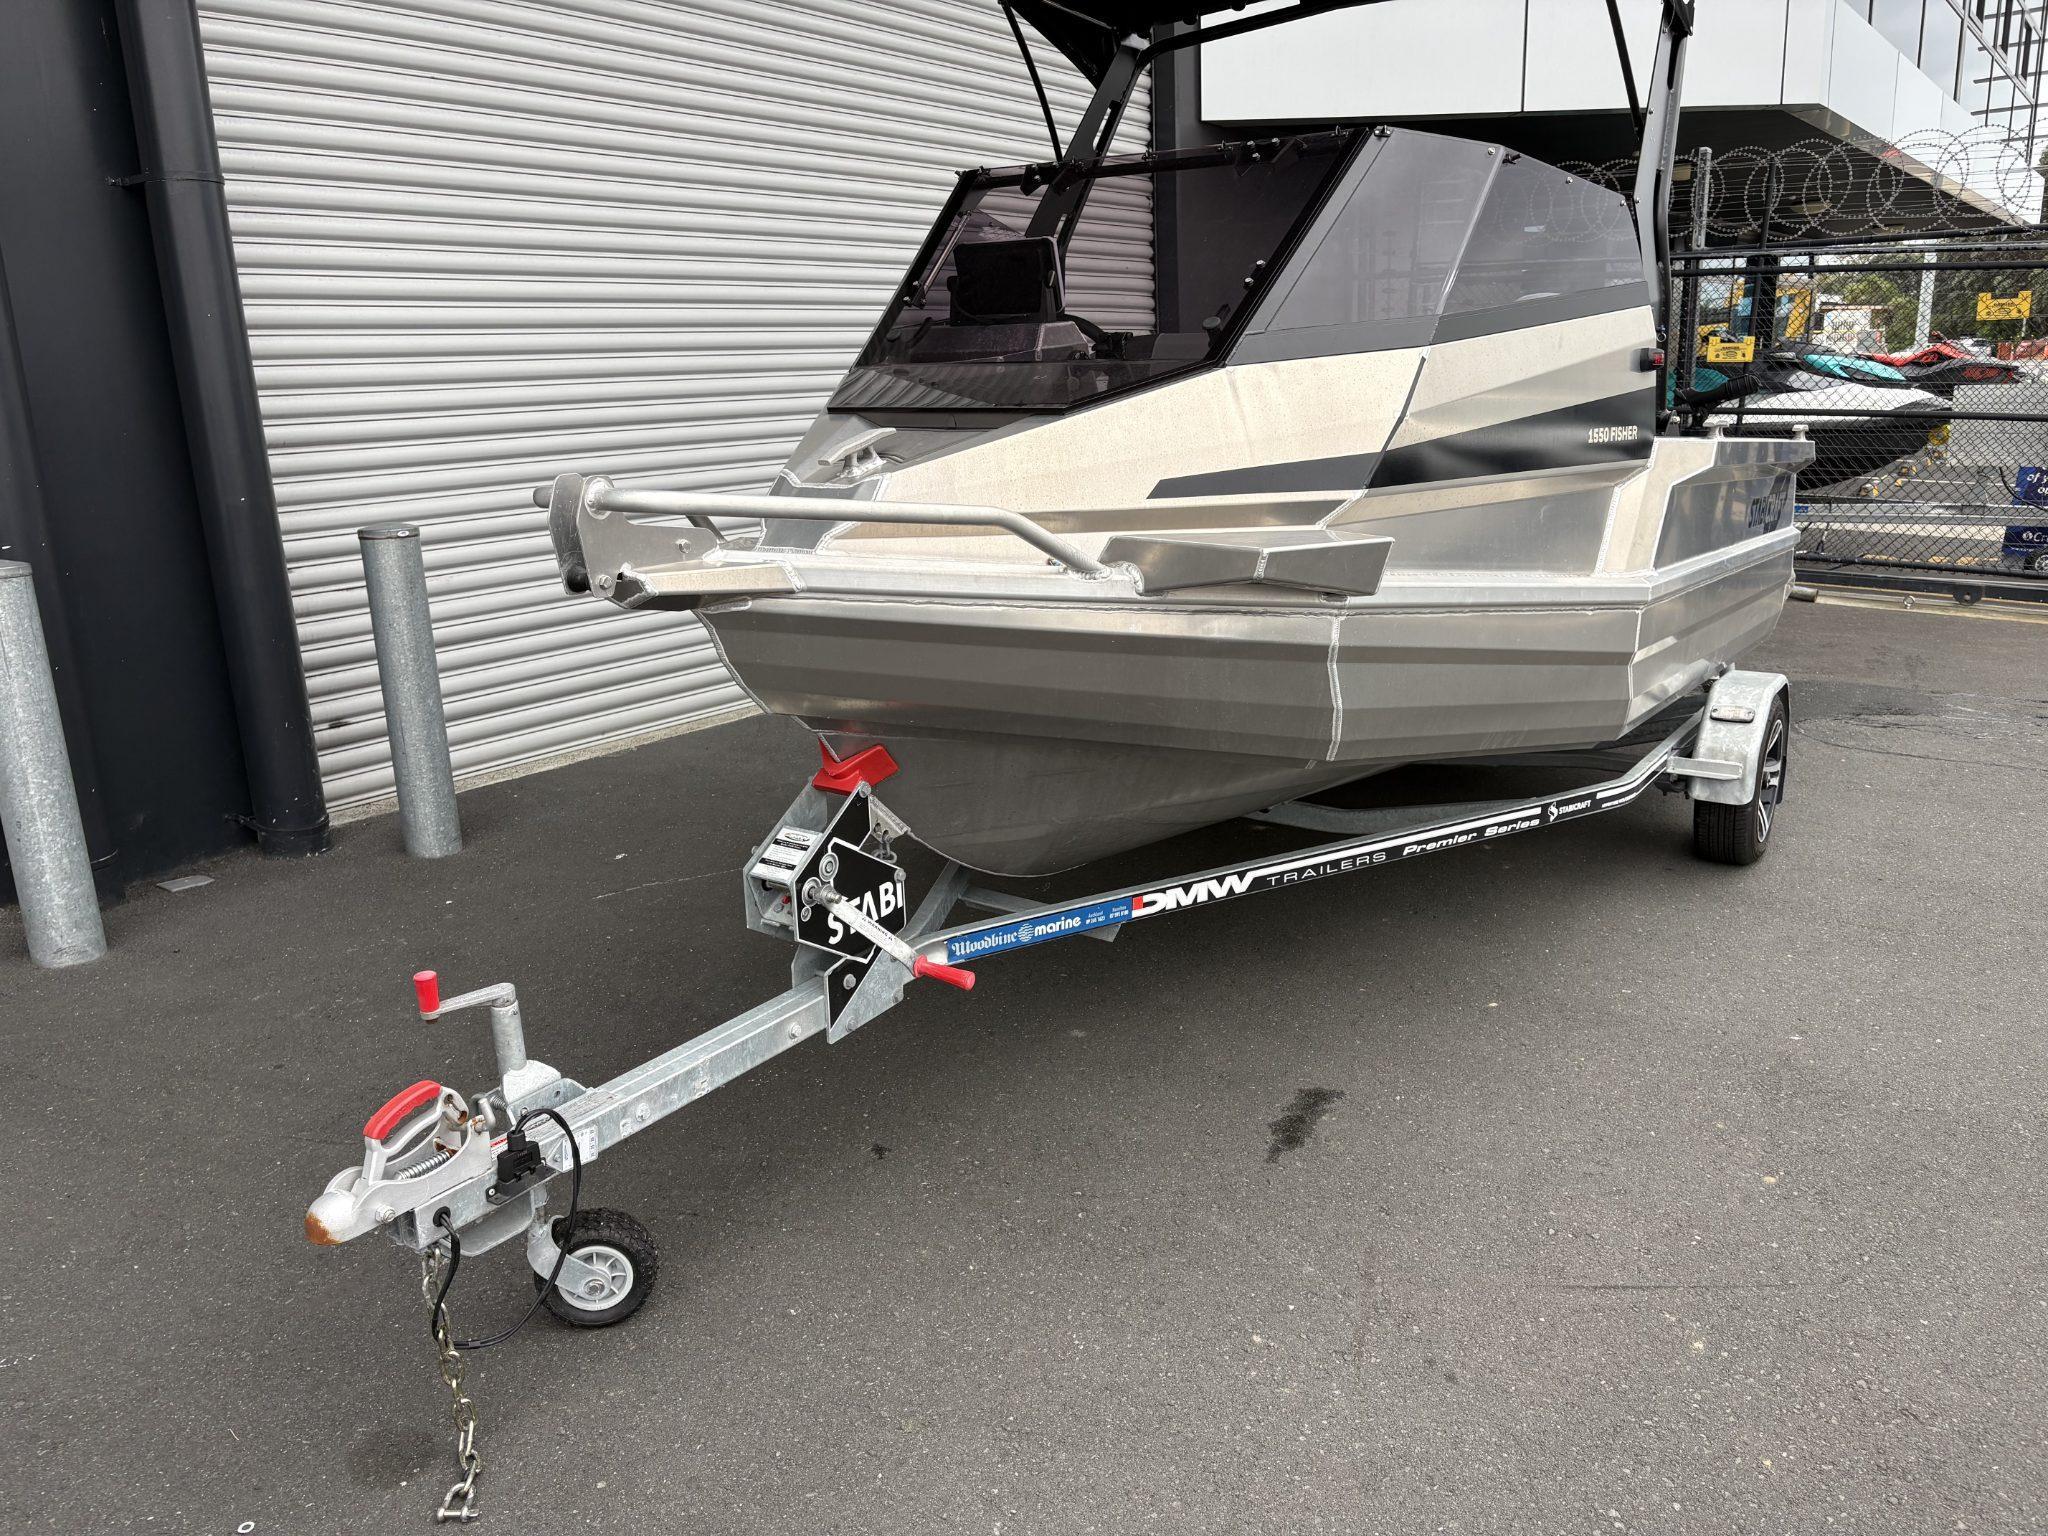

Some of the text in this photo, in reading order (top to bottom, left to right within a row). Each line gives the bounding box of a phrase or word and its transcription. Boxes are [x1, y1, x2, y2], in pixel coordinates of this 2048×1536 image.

[1588, 425, 1638, 444] 1550 FISHER
[1132, 818, 1541, 919] DMW TRAILERS Premier Series
[952, 931, 1018, 957] Woodbine
[1034, 915, 1082, 937] marine
